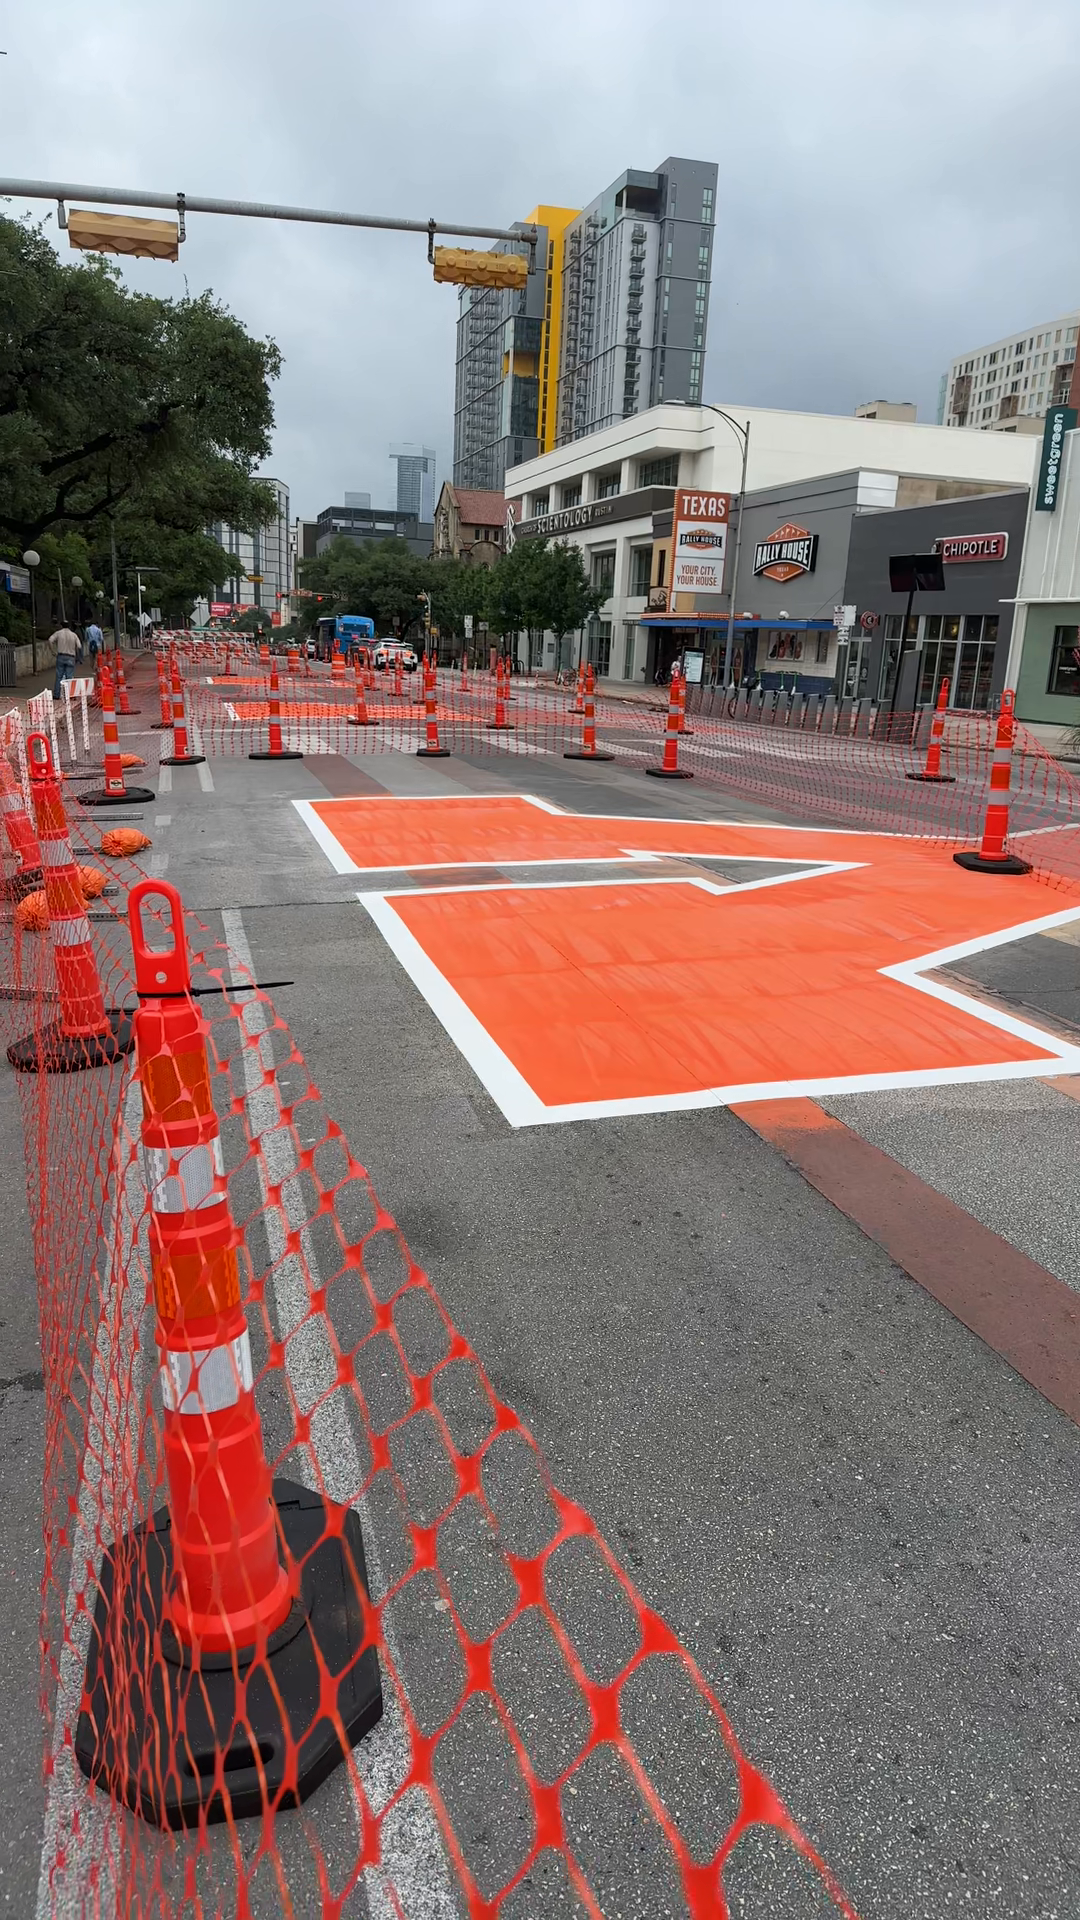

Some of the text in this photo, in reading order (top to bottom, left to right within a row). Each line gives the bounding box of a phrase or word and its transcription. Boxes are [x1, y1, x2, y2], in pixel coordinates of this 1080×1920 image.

[1044, 413, 1064, 505] sweetgreen
[682, 495, 726, 517] TEXAS
[538, 505, 593, 534] SCIENTOLOGY
[681, 535, 721, 546] RALLY HOUSE
[943, 539, 998, 556] CHIPOTLE
[755, 540, 810, 569] RALLY HOUSE
[681, 564, 699, 575] YOUR
[677, 574, 694, 585] YOUR
